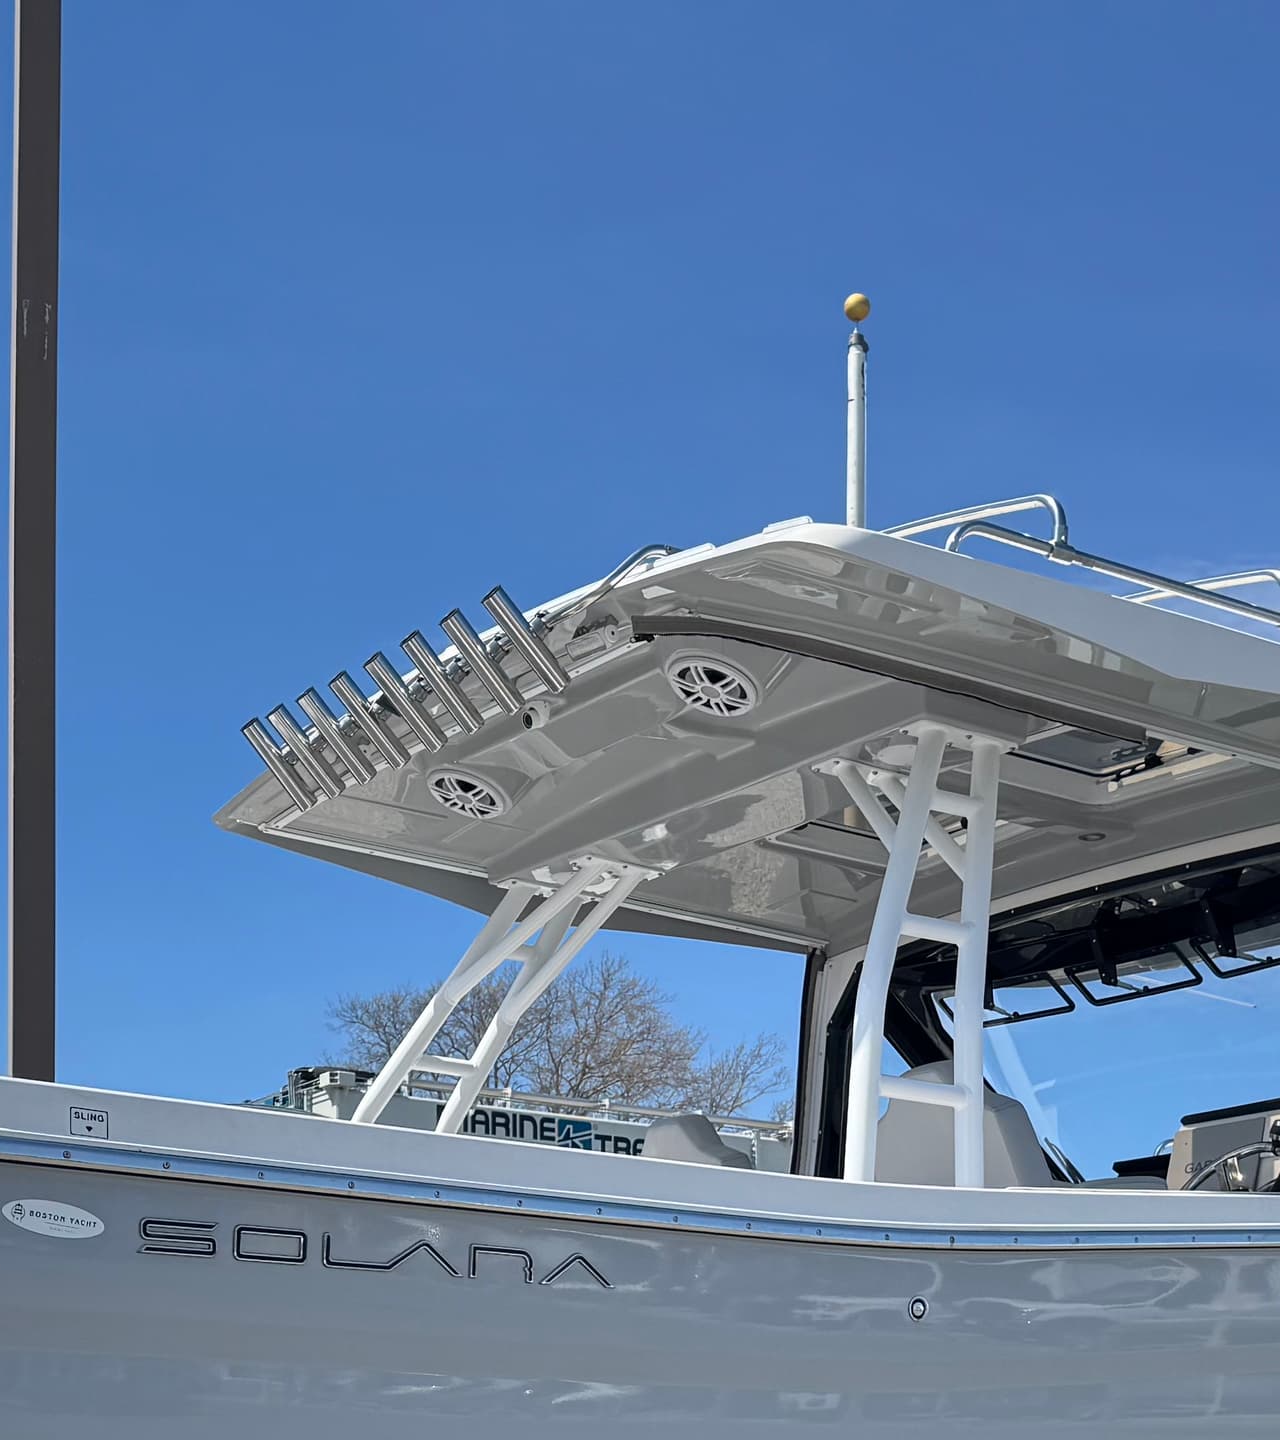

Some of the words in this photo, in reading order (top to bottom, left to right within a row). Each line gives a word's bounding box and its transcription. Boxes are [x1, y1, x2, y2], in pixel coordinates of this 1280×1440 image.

[29, 1210, 66, 1223] BOSTON
[70, 1217, 98, 1229] YACHT
[136, 1217, 616, 1289] SOLARA
